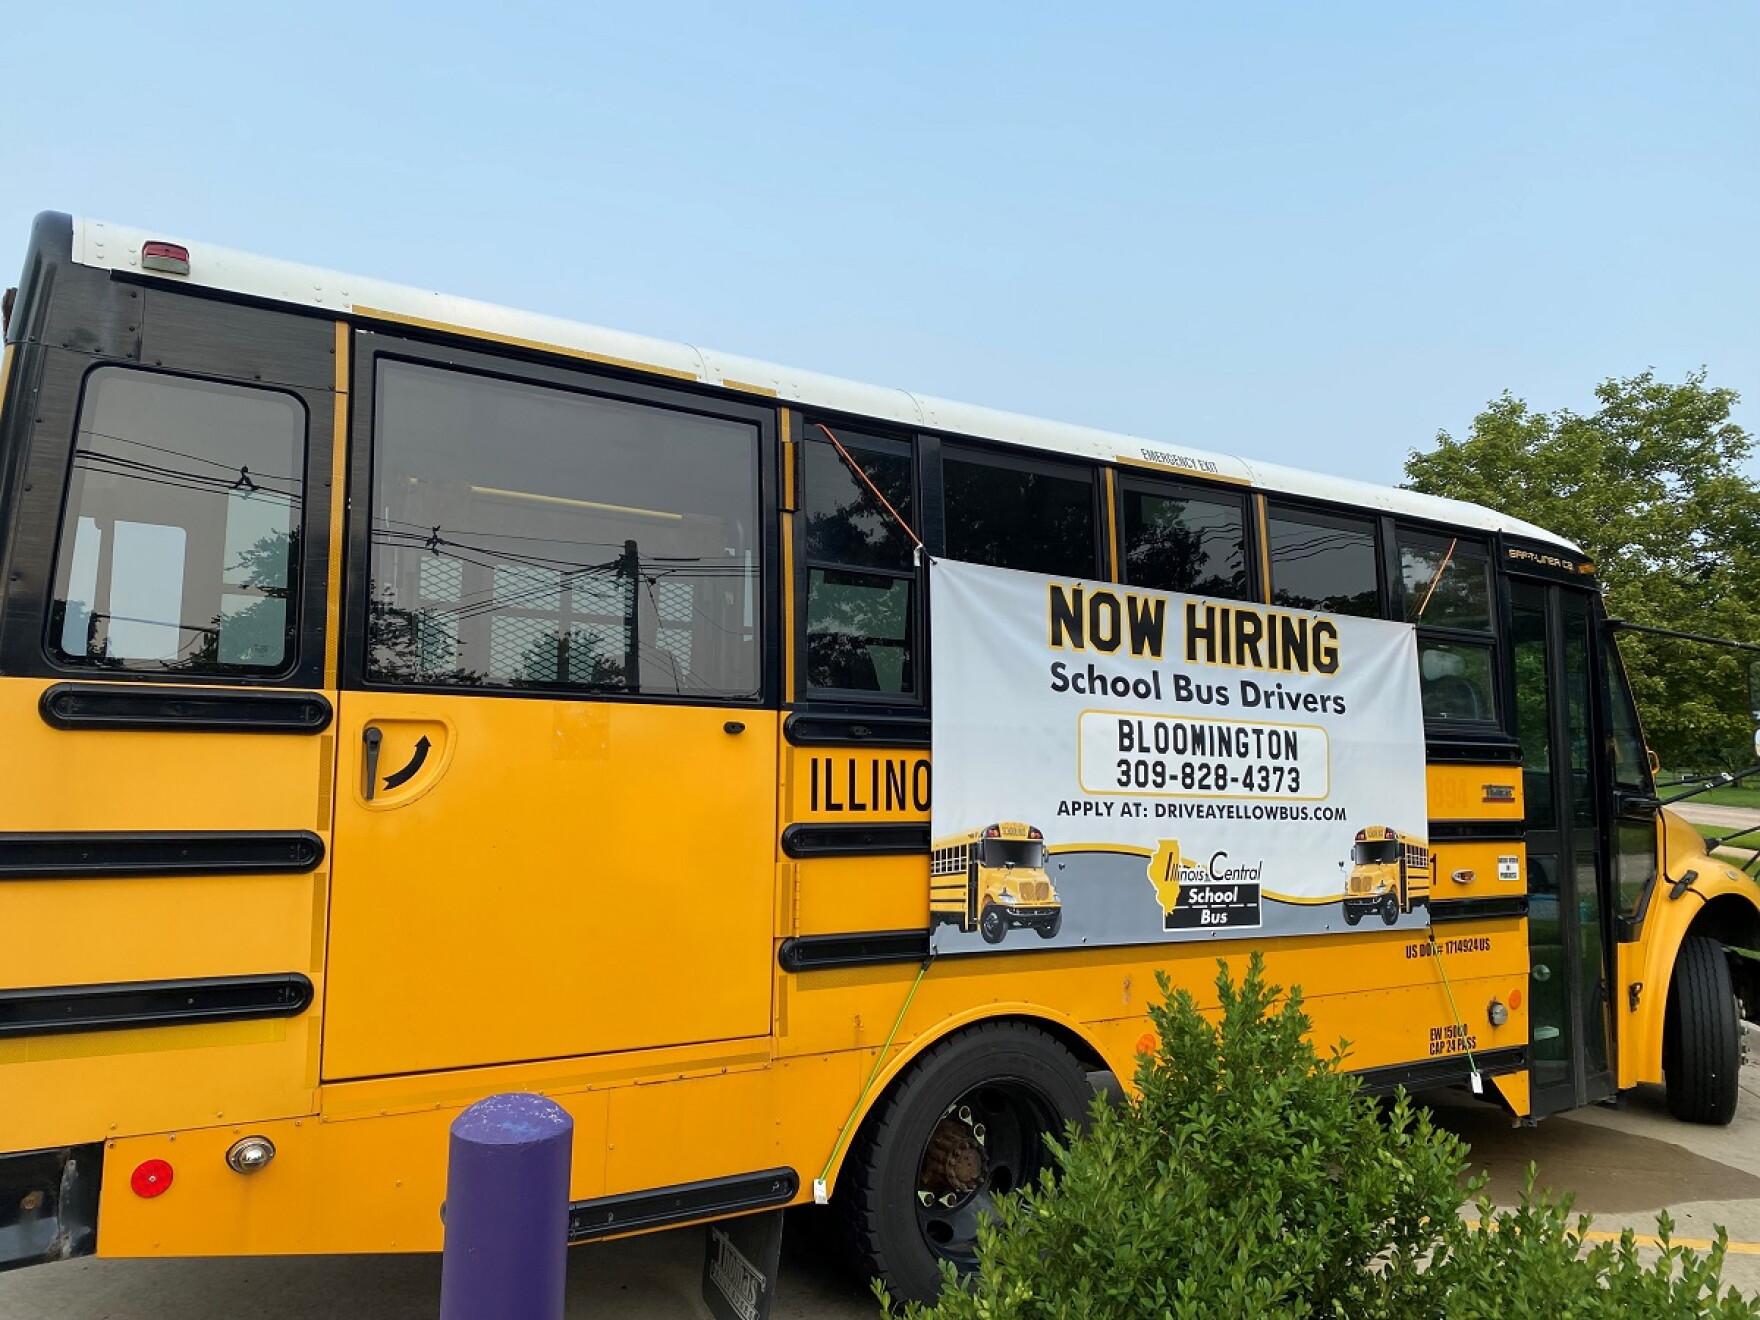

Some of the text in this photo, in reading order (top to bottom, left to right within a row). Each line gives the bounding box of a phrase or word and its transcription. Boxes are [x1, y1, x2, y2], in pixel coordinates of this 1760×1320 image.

[1140, 448, 1218, 473] EMERGENCY EXIT
[1047, 582, 1341, 678] NOW HIRING
[1050, 661, 1346, 715] School Bus Drivers
[1118, 719, 1298, 761] BLOOMINGTON
[810, 757, 931, 812] ILLINO
[1116, 758, 1301, 793] 309-828-4373
[1057, 800, 1347, 821] APPLY AT: DRIVEAYELLOWBUS.COM
[1164, 851, 1262, 881] Illinois Central
[1188, 886, 1238, 903] School
[1201, 909, 1228, 925] Bus
[1406, 945, 1417, 959] US
[1430, 1027, 1442, 1041] EW
[1430, 1041, 1445, 1056] CAP
[1446, 1040, 1456, 1053] 24
